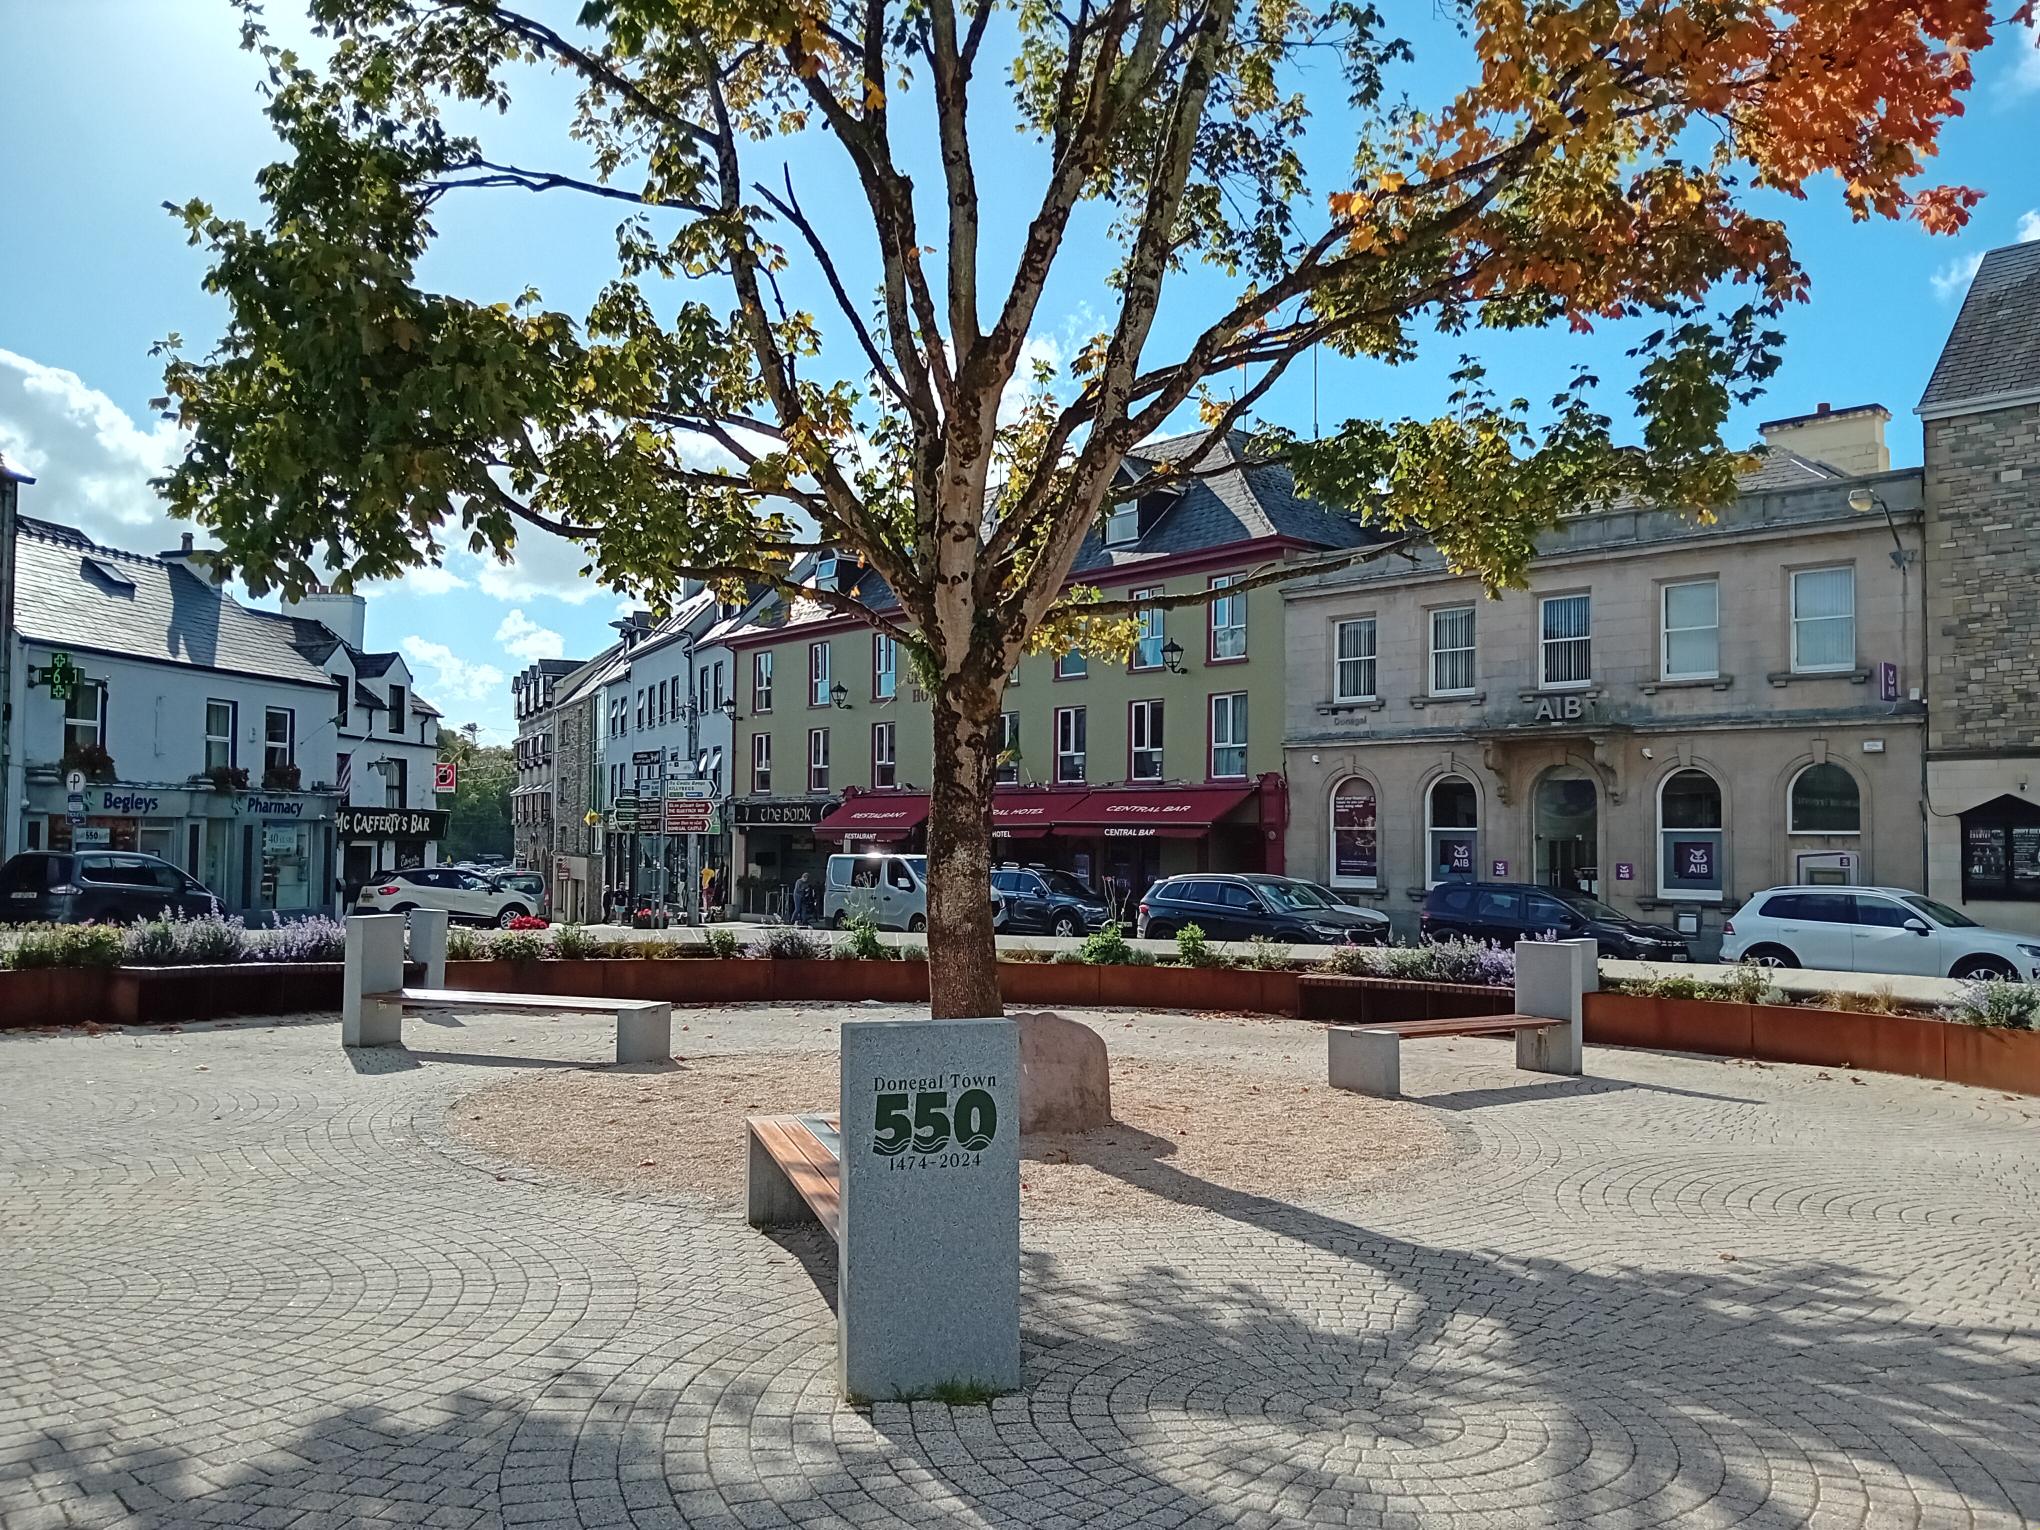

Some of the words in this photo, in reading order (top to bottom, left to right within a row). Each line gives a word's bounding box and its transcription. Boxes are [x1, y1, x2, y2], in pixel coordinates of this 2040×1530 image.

[1535, 696, 1582, 720] AIB
[1334, 715, 1367, 727] Donegal
[103, 792, 159, 813] Begleys
[247, 797, 304, 817] Pharmacy
[1105, 805, 1160, 813] CENTRAL
[410, 814, 430, 834] BAR
[1104, 828, 1137, 836] CENTRAL
[1138, 828, 1156, 836] BAR
[844, 832, 877, 840] RESTAURANT
[1453, 858, 1470, 868] AIB
[1688, 863, 1708, 873] AIB
[873, 1075, 944, 1092] Donegal
[950, 1073, 997, 1089] Town
[872, 1088, 998, 1157] 550
[889, 1153, 982, 1171] 1474-2024
